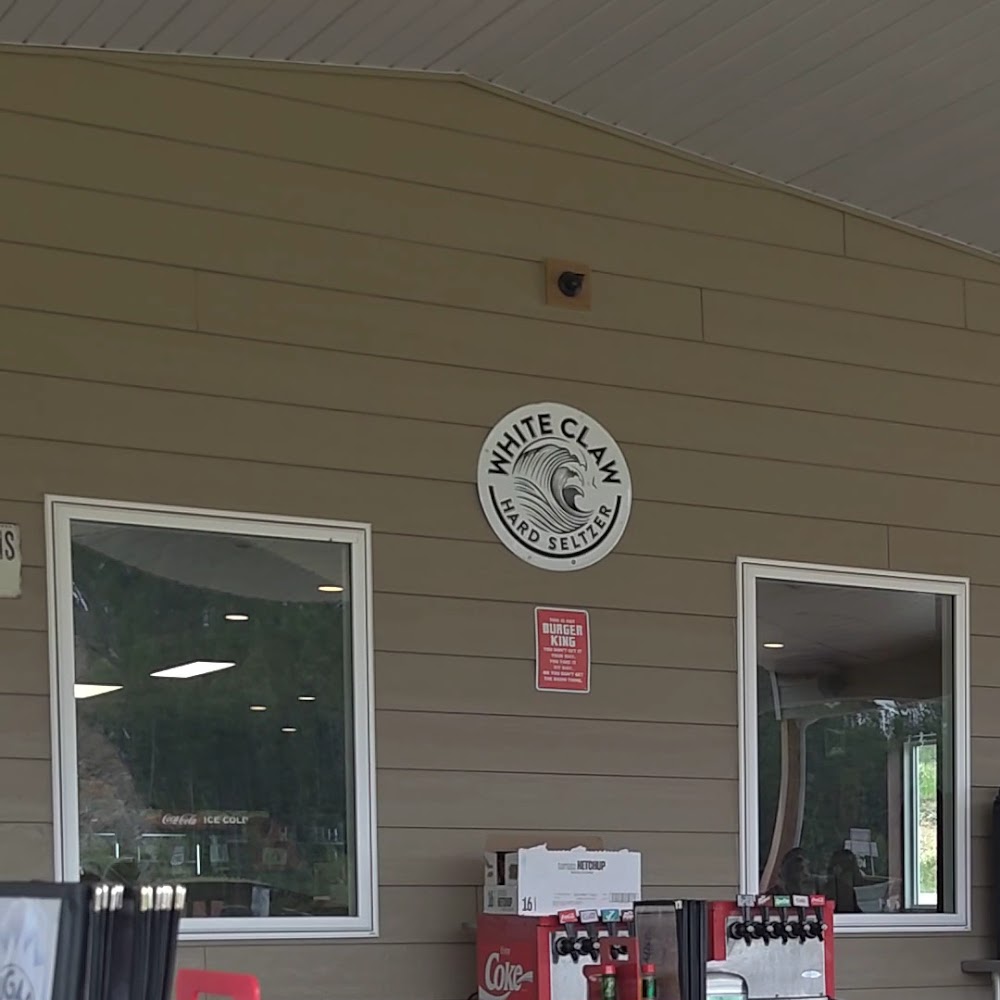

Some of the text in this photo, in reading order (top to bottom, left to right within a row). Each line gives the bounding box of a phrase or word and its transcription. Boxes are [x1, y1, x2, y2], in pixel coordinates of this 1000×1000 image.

[488, 413, 622, 484] WHITE CLAW
[500, 498, 612, 550] HARD SELTZER
[542, 622, 583, 636] BURGER
[550, 635, 576, 647] KING
[485, 952, 523, 991] Coke
